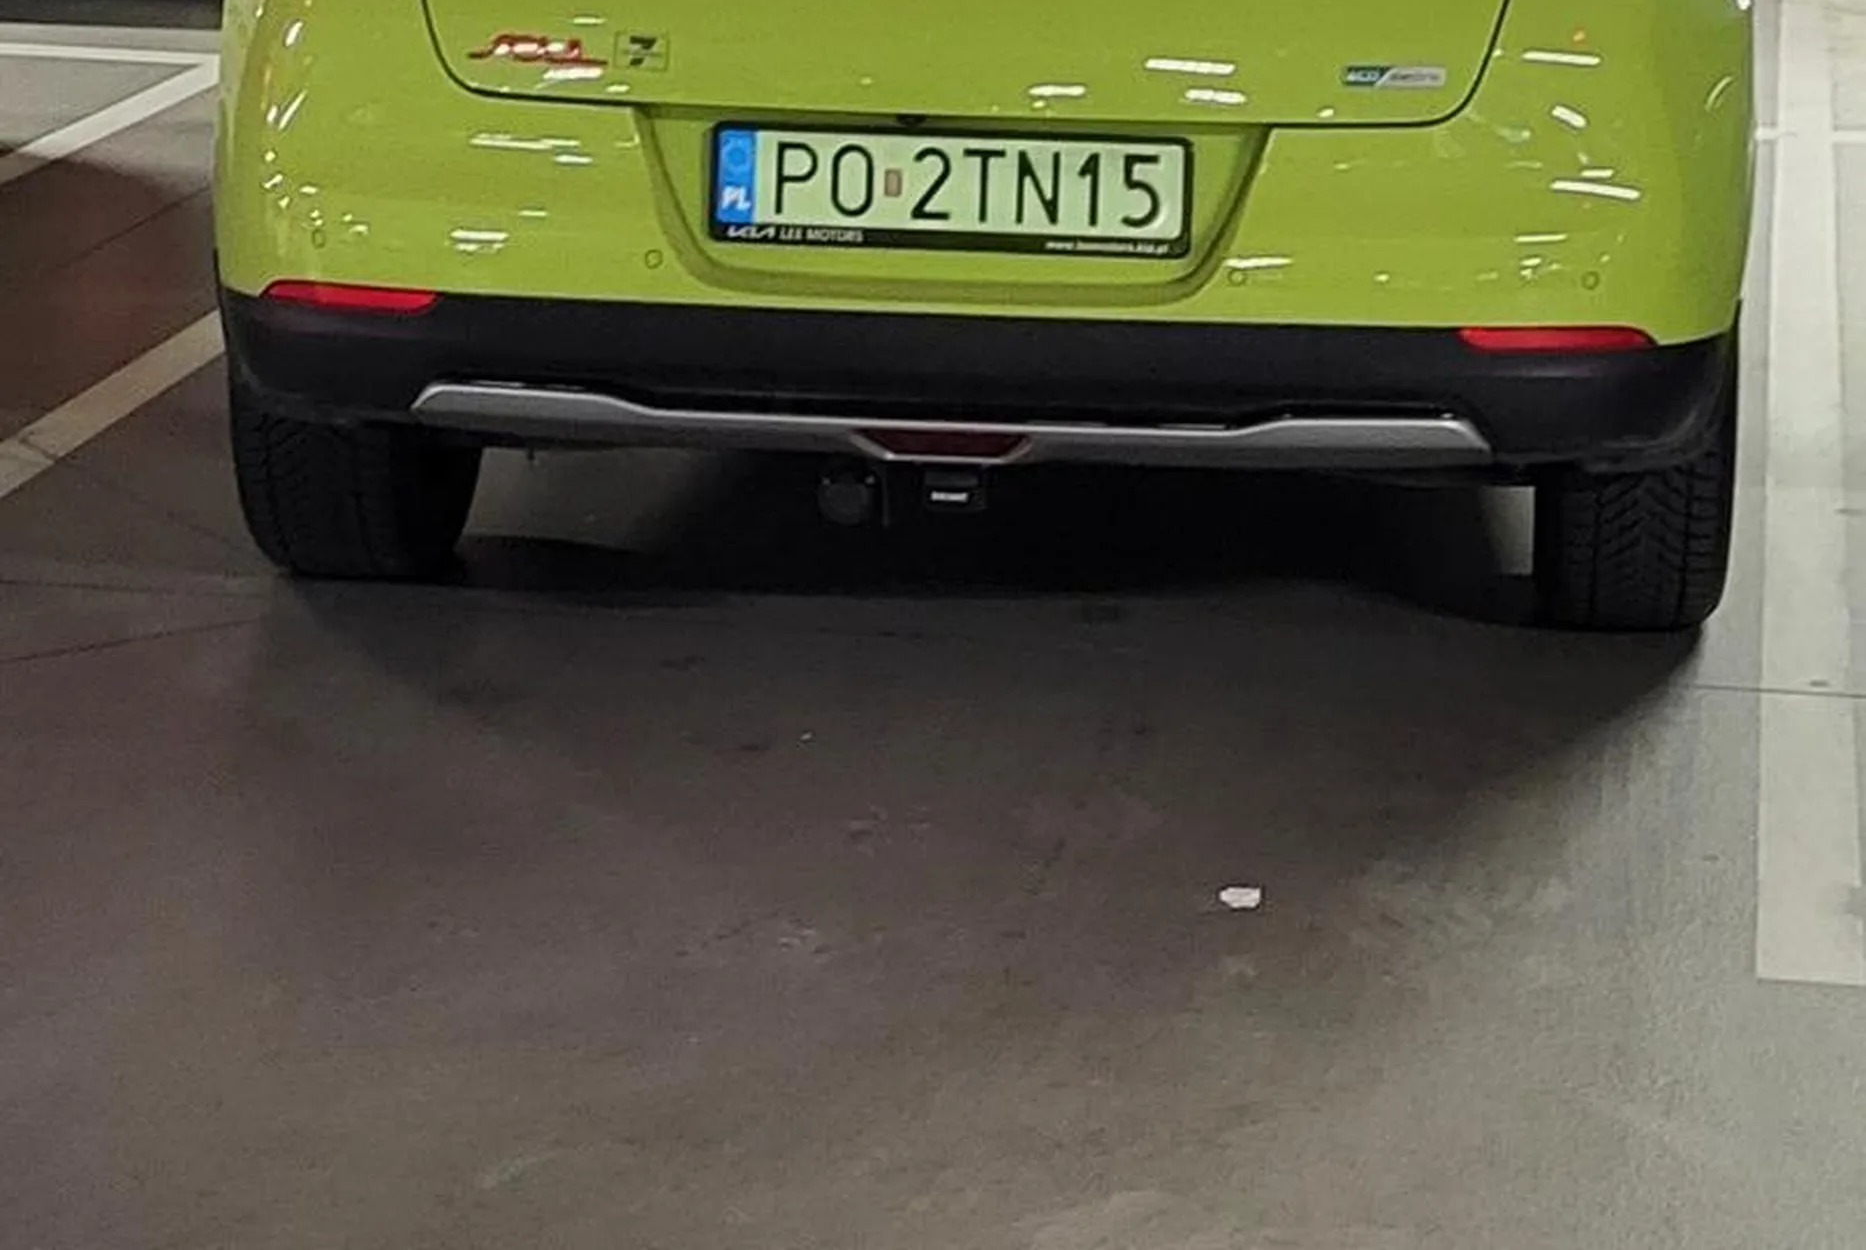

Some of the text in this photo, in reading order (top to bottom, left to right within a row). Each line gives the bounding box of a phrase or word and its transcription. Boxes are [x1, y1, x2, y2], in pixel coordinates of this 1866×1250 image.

[775, 140, 1161, 228] PO 2TN15
[721, 185, 751, 211] PL
[806, 229, 864, 243] MOTORS
